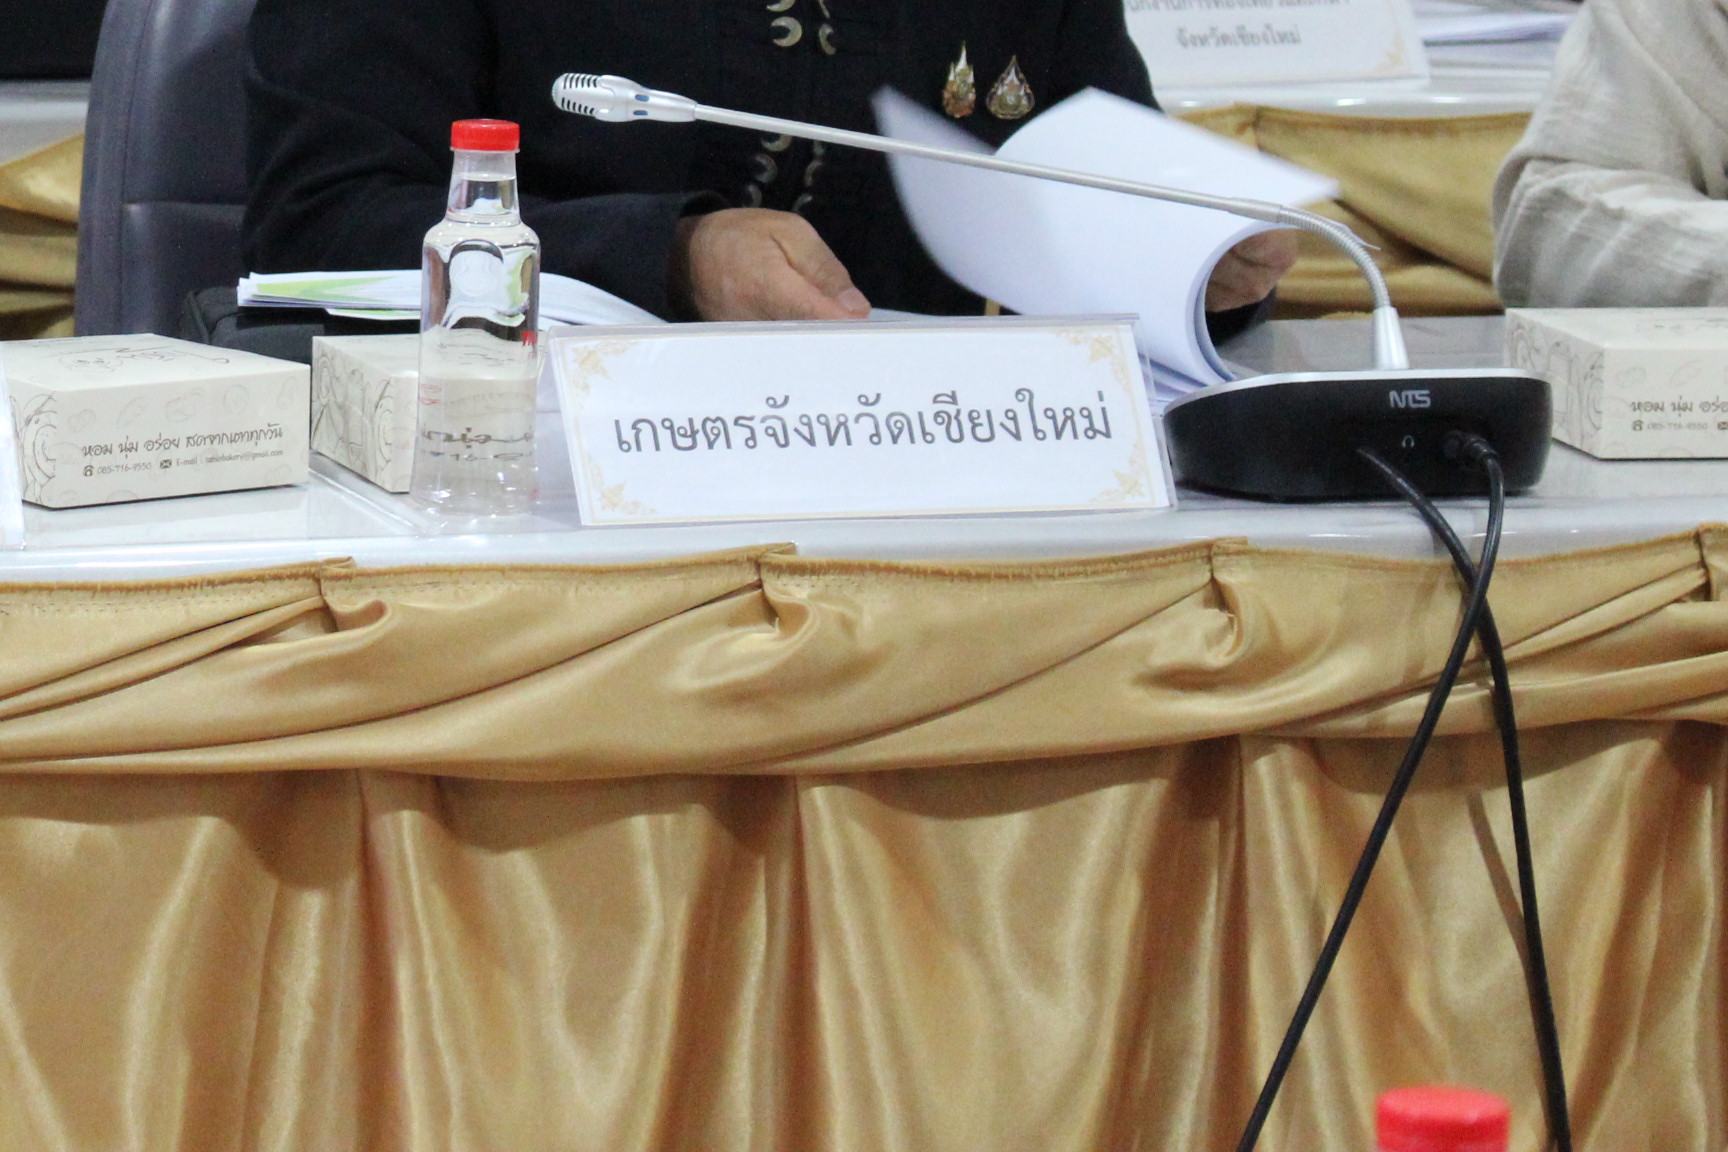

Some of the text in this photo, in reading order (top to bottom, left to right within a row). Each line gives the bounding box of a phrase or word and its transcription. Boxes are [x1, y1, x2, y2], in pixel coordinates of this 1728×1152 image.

[1389, 389, 1431, 408] NTS
[613, 386, 1112, 453] เกษตรจังหวัดเชียงใหม่
[81, 443, 113, 457] หอม
[118, 435, 139, 459] นุ่ม
[144, 433, 180, 452] อร่อย
